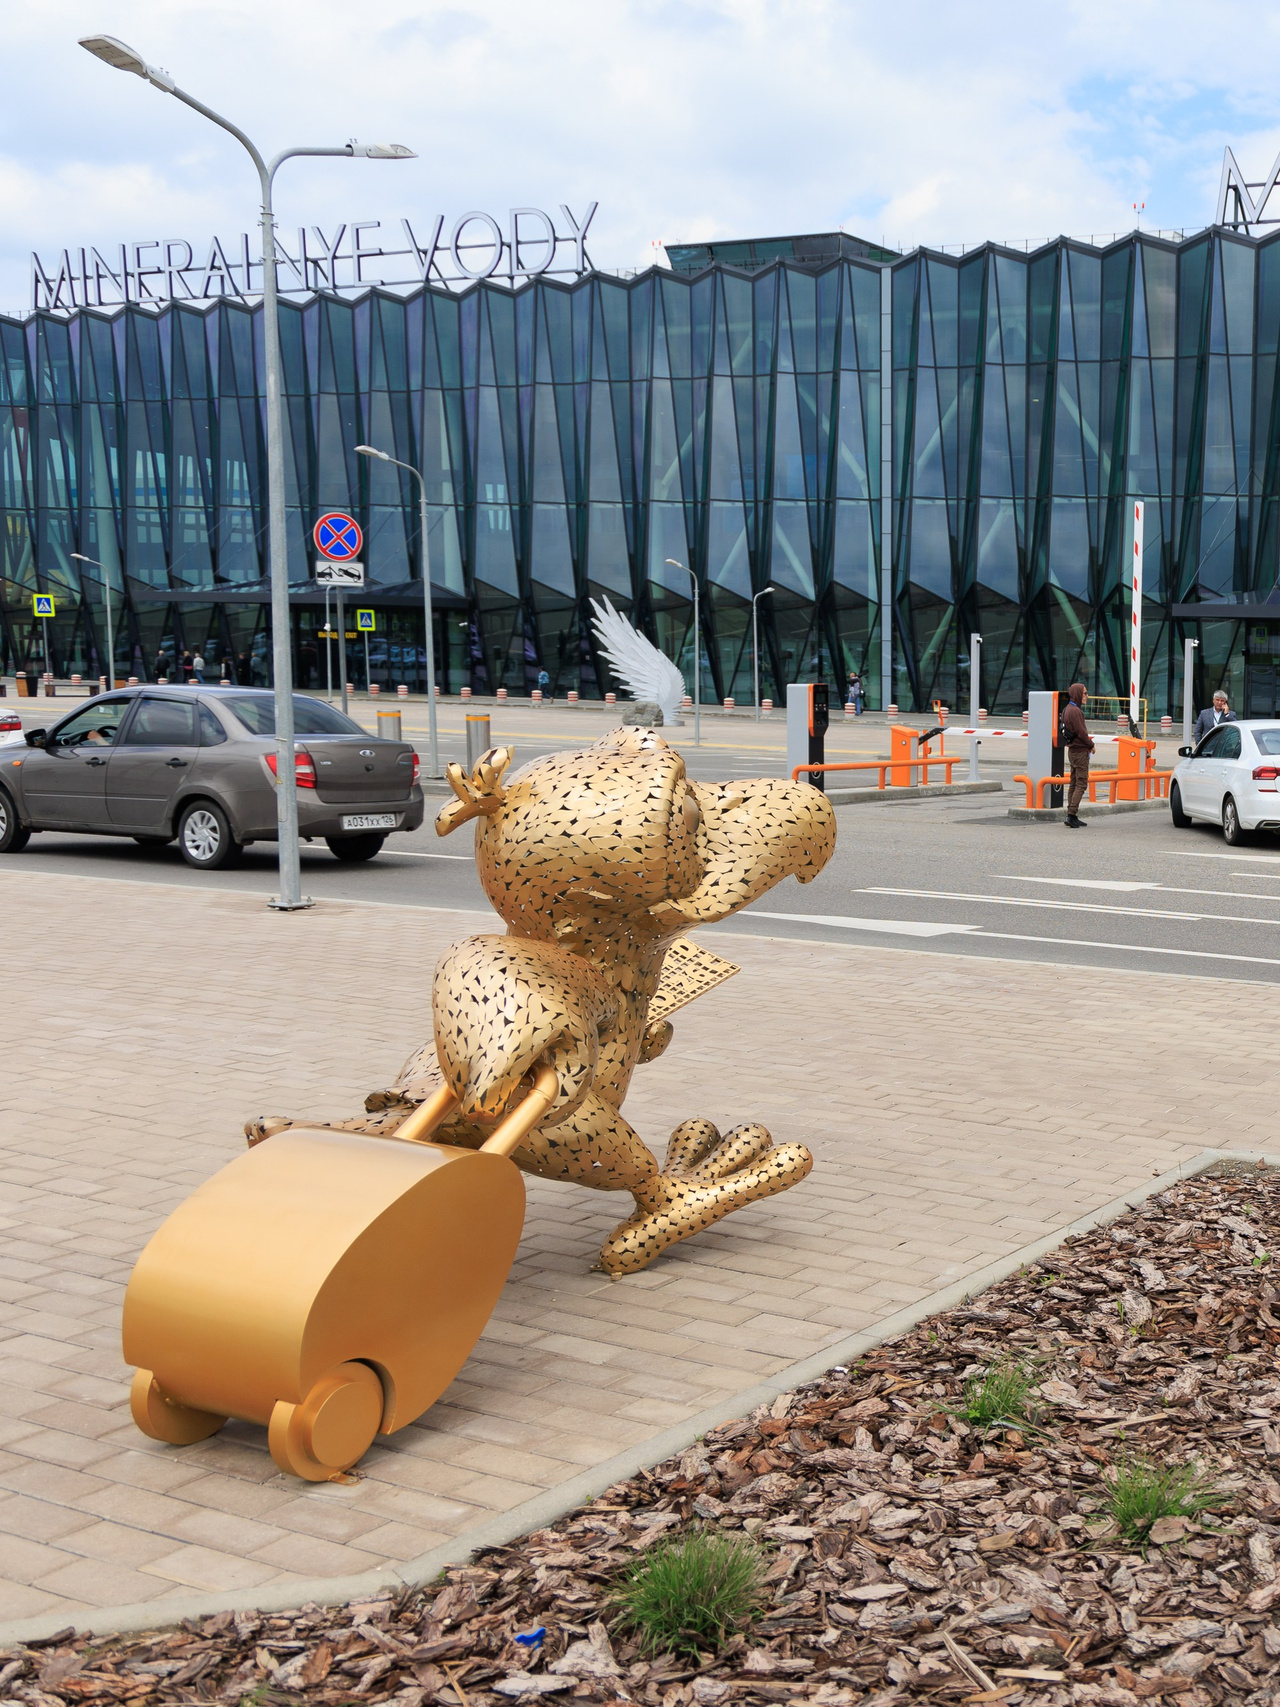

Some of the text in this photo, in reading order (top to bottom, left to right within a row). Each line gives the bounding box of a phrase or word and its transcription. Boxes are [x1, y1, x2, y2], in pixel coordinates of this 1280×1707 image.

[31, 201, 599, 308] MINERALNYE VODY
[382, 815, 394, 824] 126
